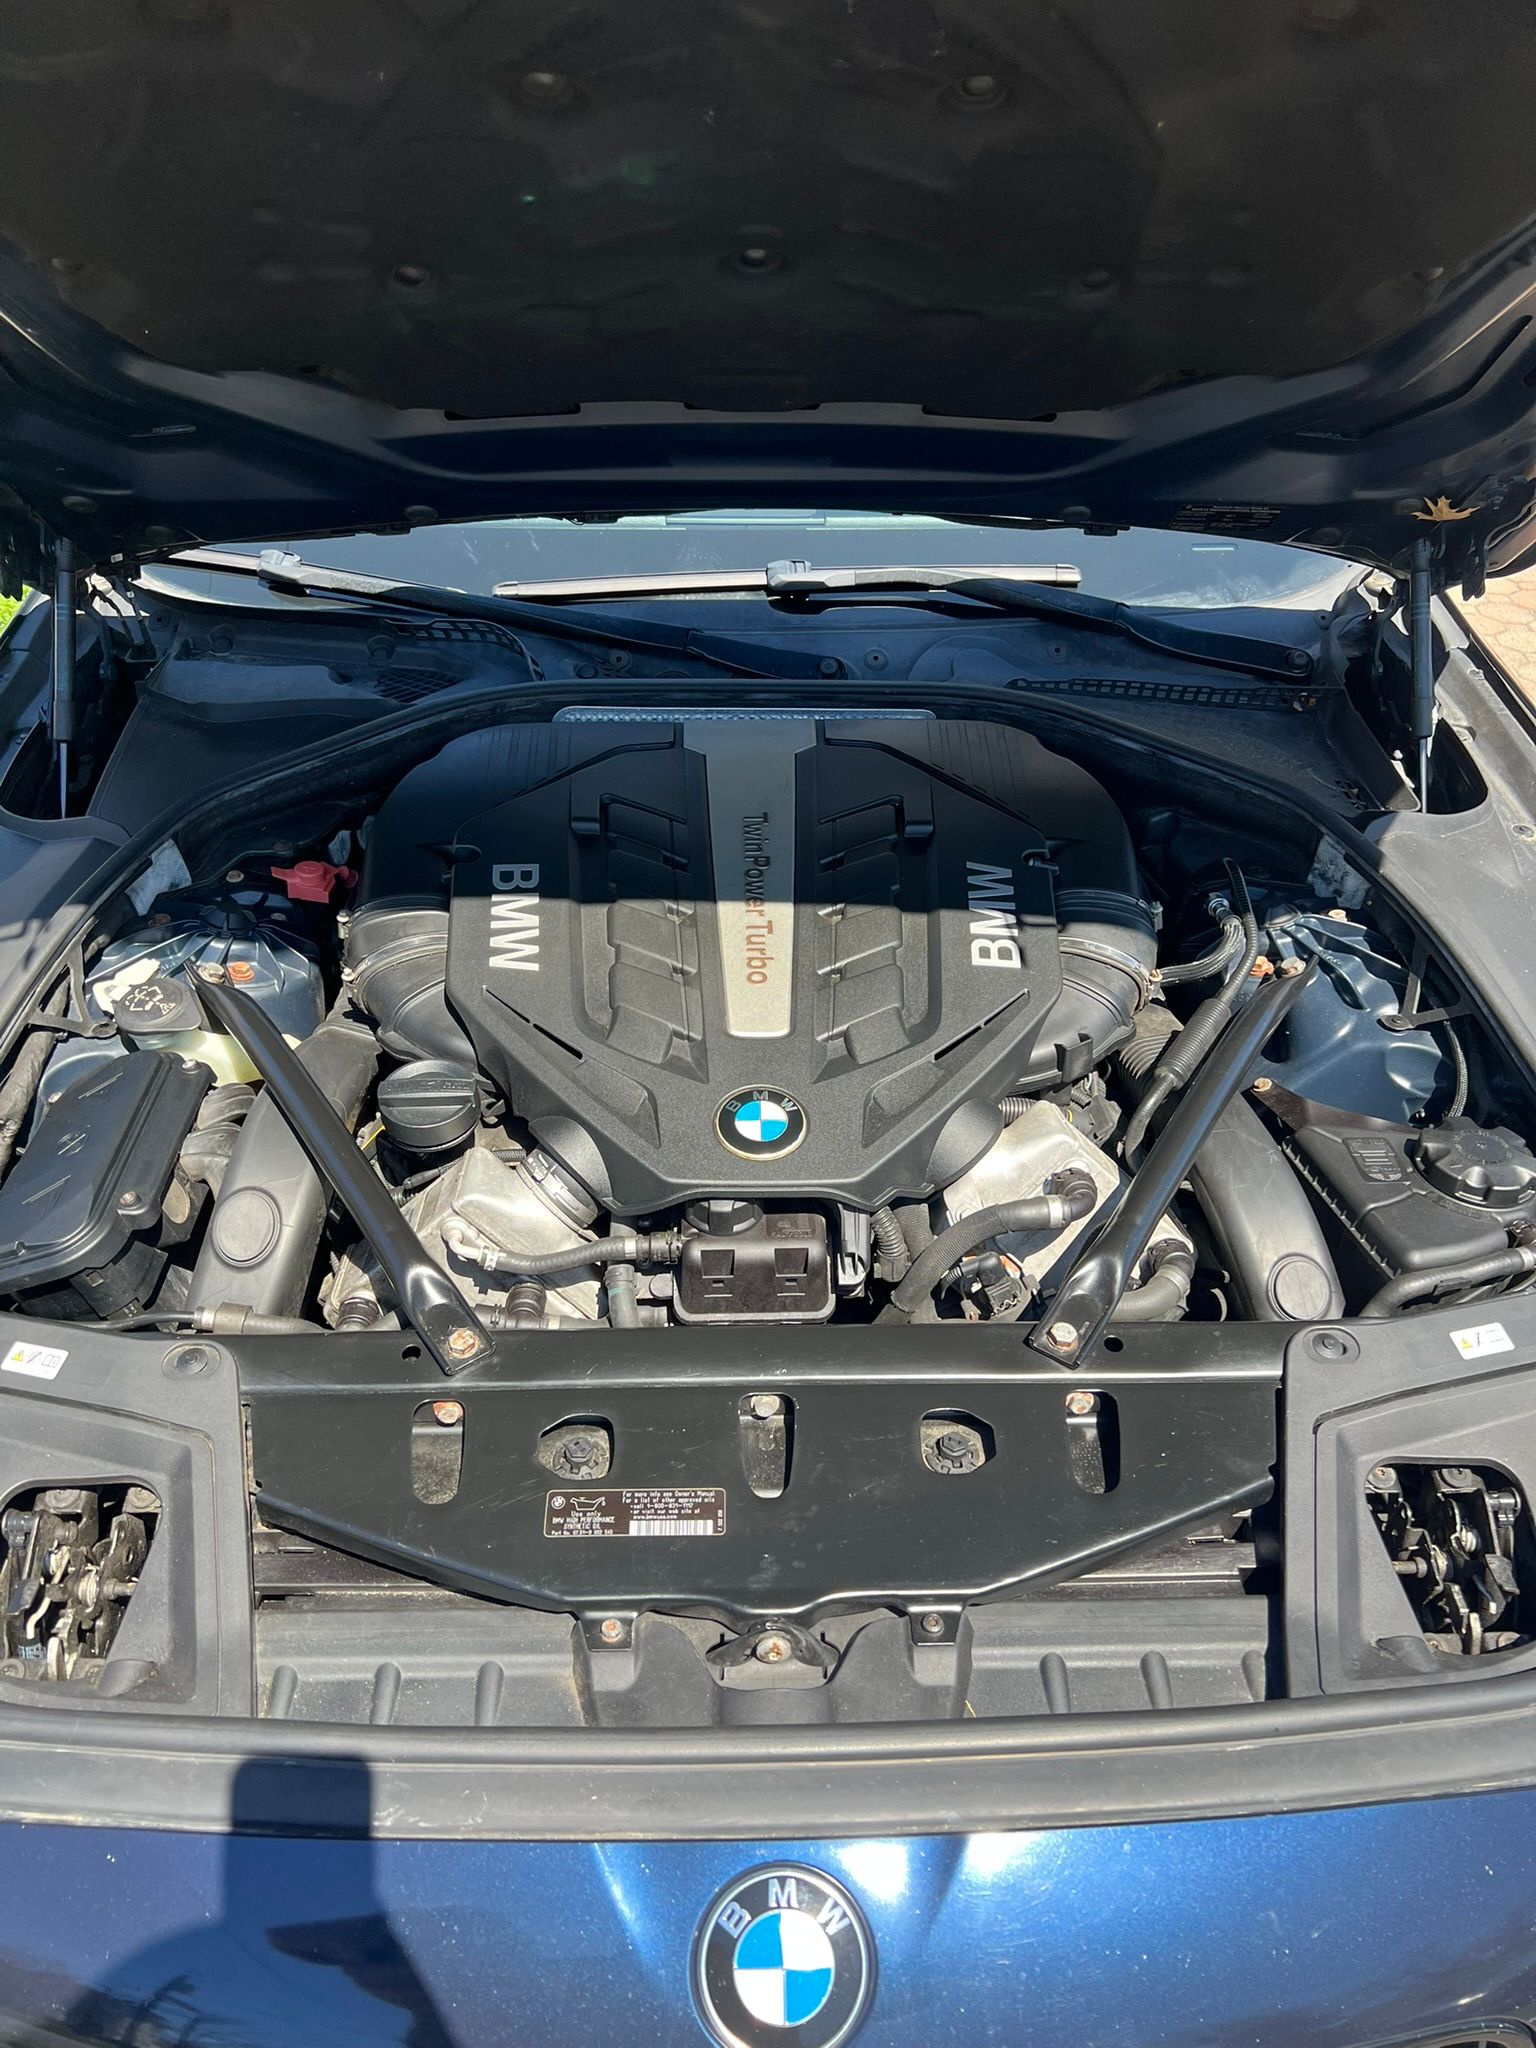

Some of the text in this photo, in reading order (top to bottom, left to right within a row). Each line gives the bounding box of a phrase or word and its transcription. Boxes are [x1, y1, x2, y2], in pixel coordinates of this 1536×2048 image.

[489, 864, 539, 971] BMW
[743, 811, 774, 985] TwinPower Turbo
[966, 861, 1021, 968] BMW
[725, 1090, 798, 1112] BMW
[717, 1878, 850, 1938] BMW
